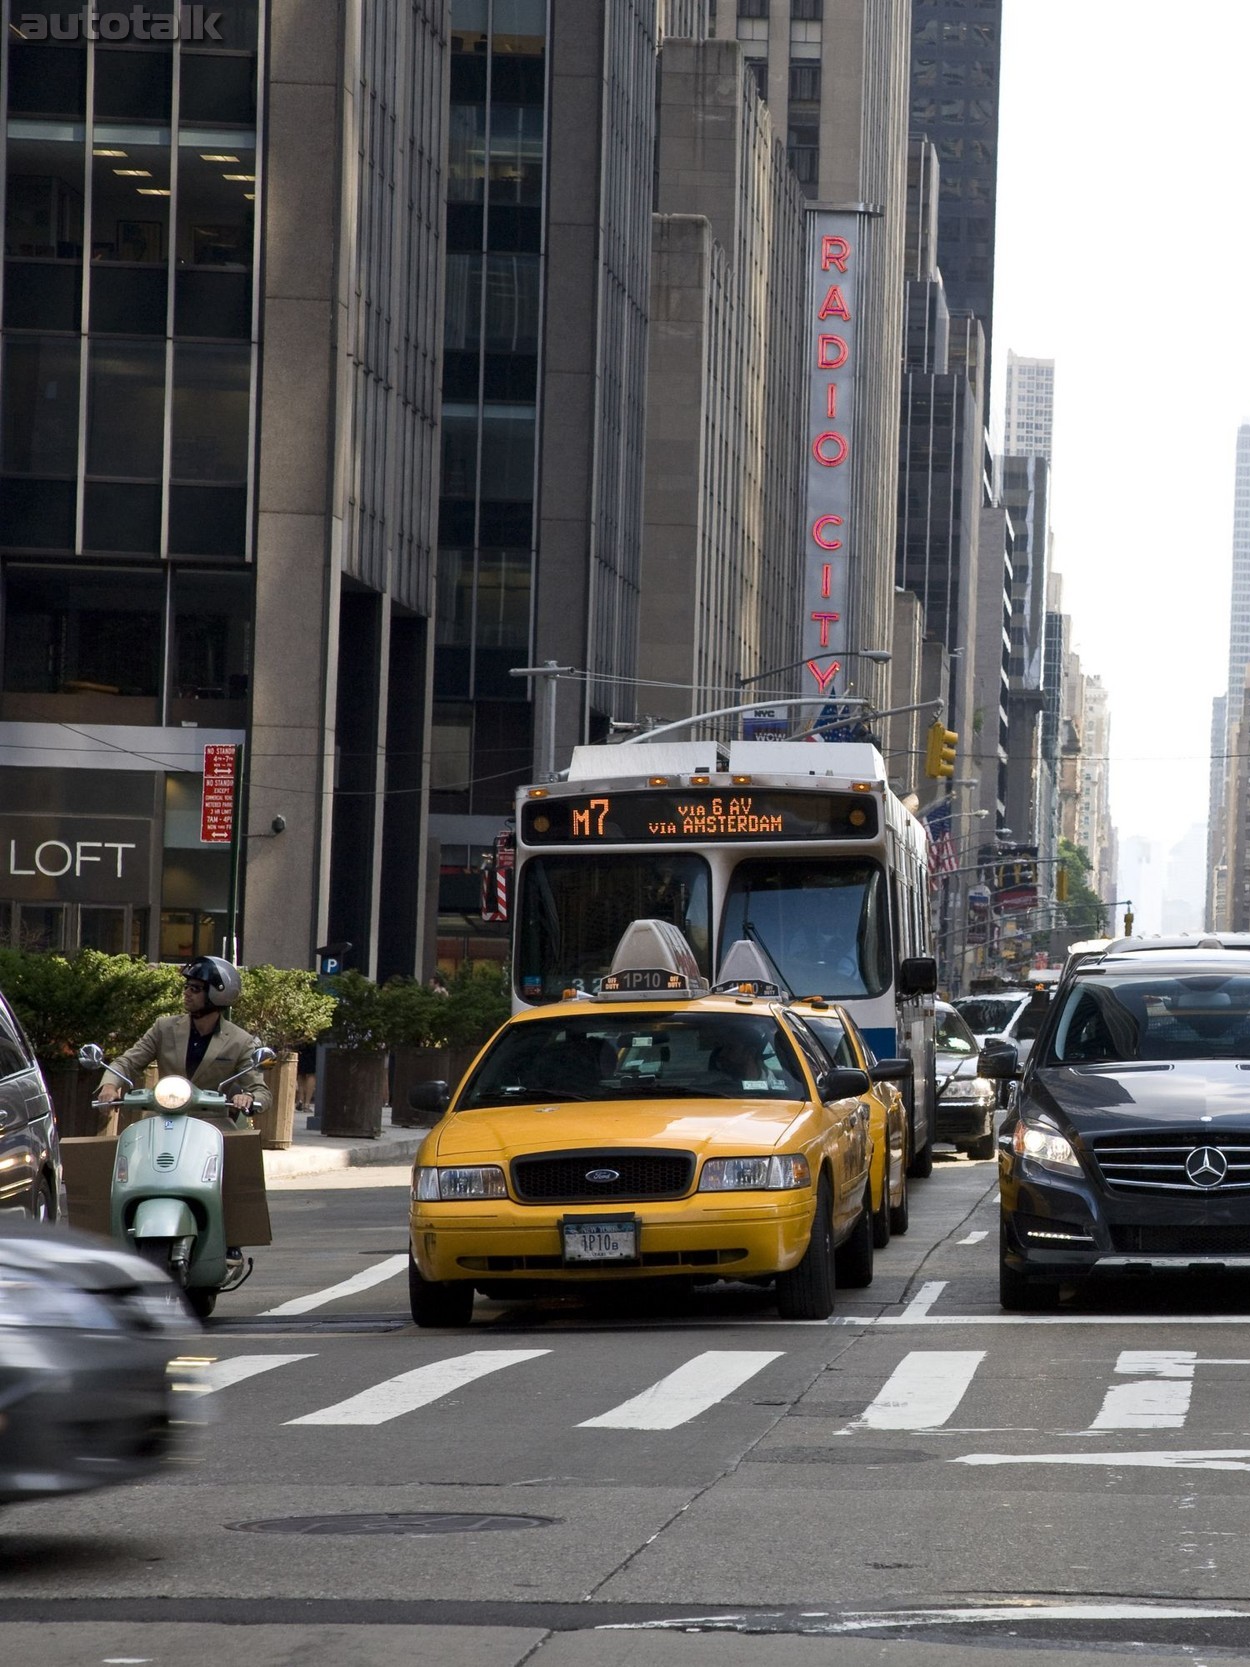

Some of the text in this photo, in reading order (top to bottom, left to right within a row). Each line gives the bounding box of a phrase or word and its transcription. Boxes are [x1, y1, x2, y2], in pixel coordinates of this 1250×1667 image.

[806, 235, 851, 693] RADIO CITY
[754, 710, 775, 718] NYC
[207, 747, 215, 755] NO
[206, 779, 214, 787] NO
[712, 798, 722, 816] 6
[730, 798, 752, 815] AV
[572, 798, 610, 836] M7
[683, 814, 782, 834] AMSTERDAM
[10, 839, 136, 878] LOFT
[327, 958, 338, 973] P
[623, 973, 661, 988] 1P10
